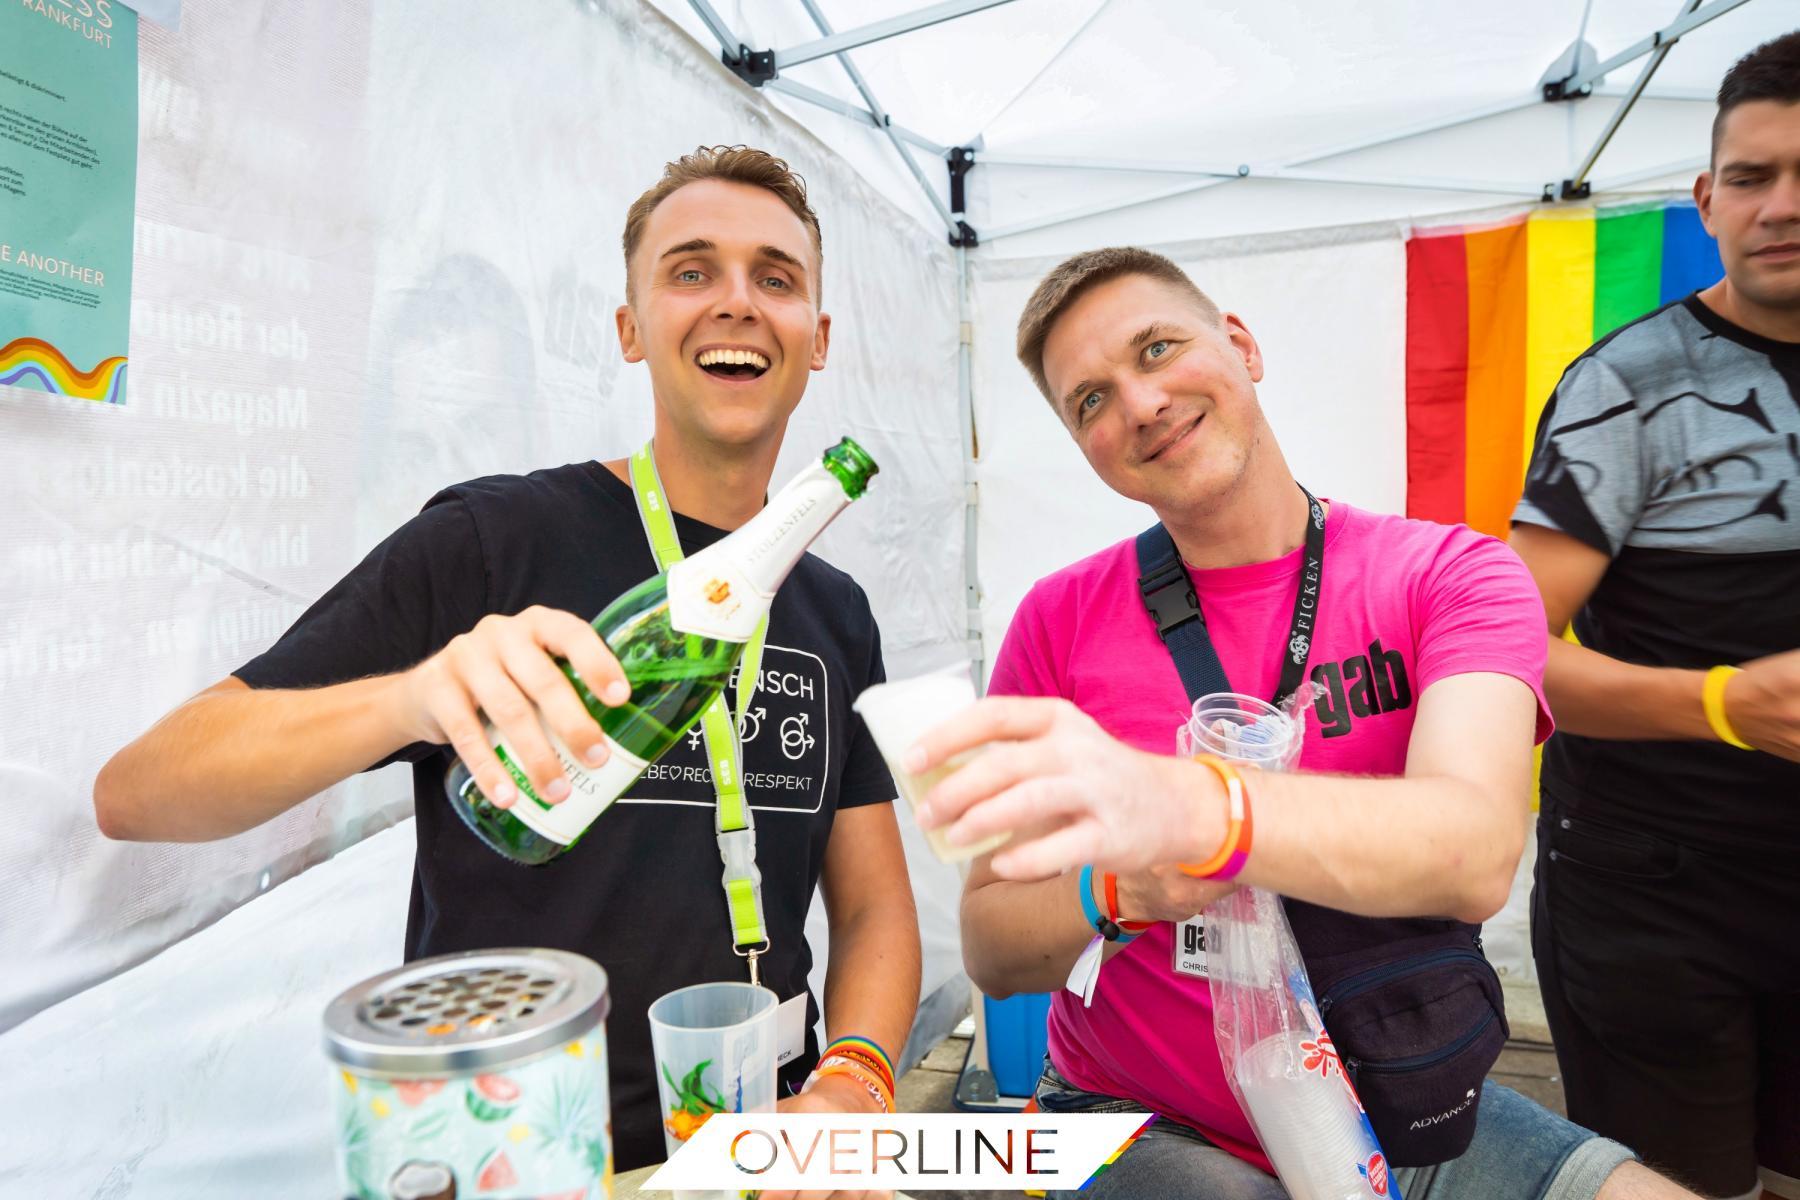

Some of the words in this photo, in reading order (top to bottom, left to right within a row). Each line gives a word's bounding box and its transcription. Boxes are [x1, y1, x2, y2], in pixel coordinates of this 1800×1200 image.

[57, 0, 112, 28] SS
[17, 250, 105, 288] ANOTHER
[1297, 557, 1320, 631] FICKEN
[728, 665, 814, 701] ENSCH
[1310, 638, 1413, 739] gab
[683, 767, 712, 783] REC
[743, 773, 813, 791] RESPEKT
[1182, 961, 1209, 973] CHRIS
